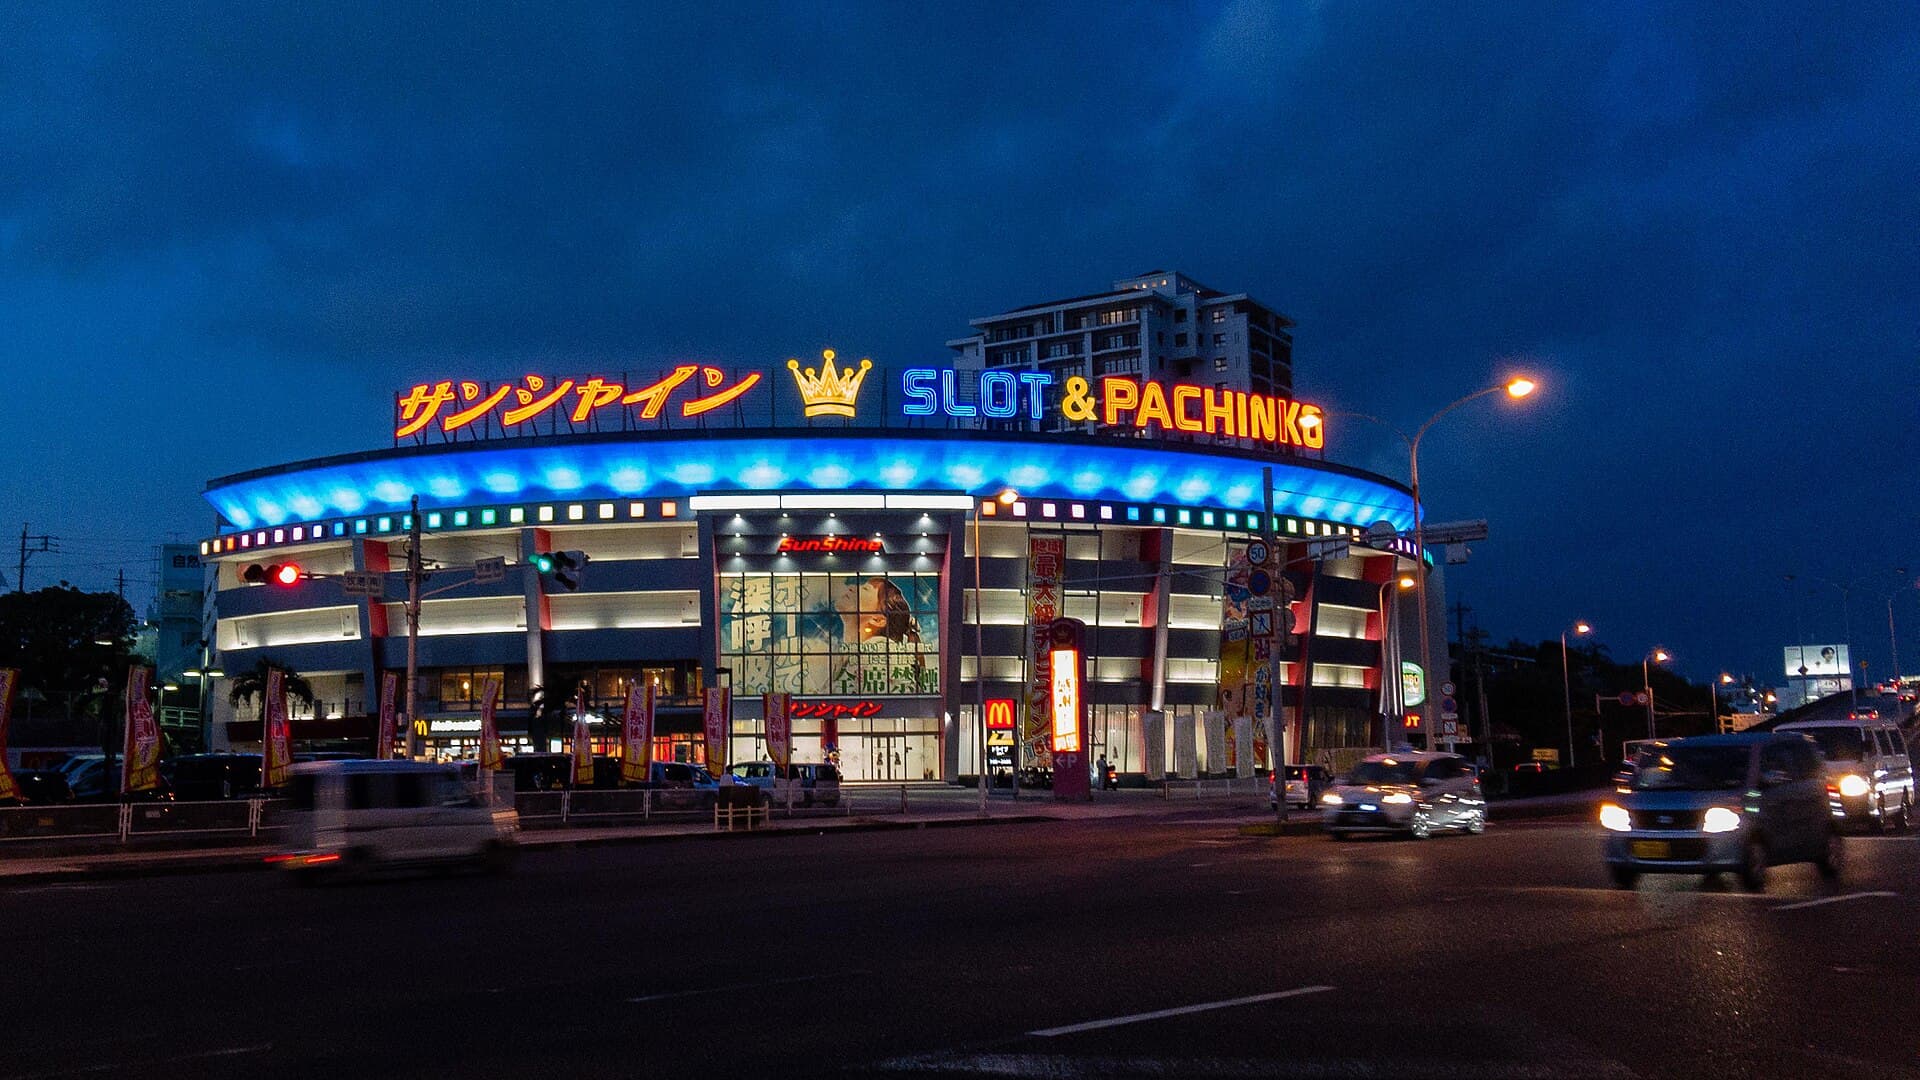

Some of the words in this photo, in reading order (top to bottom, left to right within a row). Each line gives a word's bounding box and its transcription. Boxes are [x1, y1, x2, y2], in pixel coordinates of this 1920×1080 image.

[396, 365, 760, 437] サンシャイン
[903, 368, 1052, 419] SLOT
[1062, 376, 1098, 422] &
[1104, 377, 1324, 448] PACHINKO
[777, 537, 883, 552] SunShine
[1251, 547, 1265, 560] 50
[730, 580, 772, 694] 深呼吸
[834, 666, 939, 694] 全席禁煙
[1067, 754, 1077, 769] P
